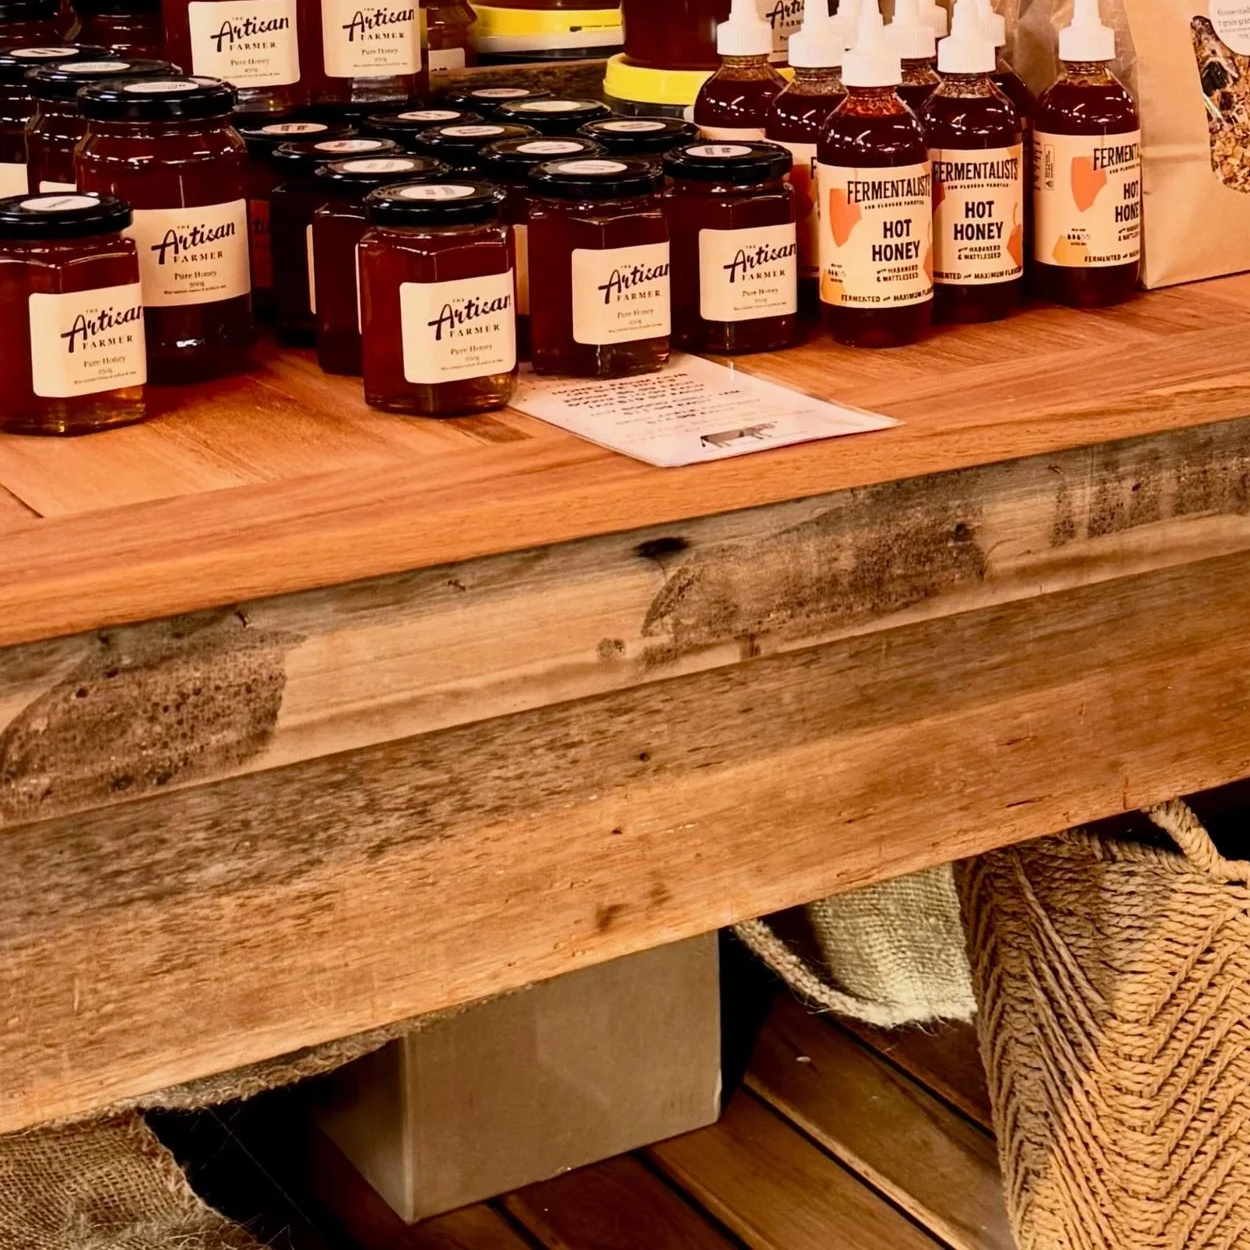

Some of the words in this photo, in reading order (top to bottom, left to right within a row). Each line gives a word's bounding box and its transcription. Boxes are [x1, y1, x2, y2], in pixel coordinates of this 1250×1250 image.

[342, 7, 415, 42] Artisan
[779, 18, 804, 28] FARM
[210, 16, 289, 53] Artisan
[360, 32, 405, 41] FARMER
[229, 42, 276, 51] FARMER
[1093, 142, 1138, 171] FERMENT
[931, 157, 1018, 184] FERMENTALISTS
[964, 200, 995, 219] HOT
[1115, 201, 1139, 223] HONE
[883, 218, 912, 239] HOT
[953, 221, 1004, 241] HONEY
[151, 222, 235, 265] Artisan
[871, 240, 921, 262] HONEY
[173, 250, 224, 263] FARMER
[723, 243, 796, 284] Artisan
[1084, 253, 1121, 263] FERMENTED
[174, 272, 192, 281] Pure
[194, 269, 217, 279] Honey
[742, 269, 786, 281] FARMER
[617, 289, 661, 302] FARMER
[841, 294, 880, 303] FERMENTED
[427, 294, 511, 341] Artisan
[449, 324, 501, 338] FARMER
[82, 334, 134, 350] FARMER
[450, 347, 468, 355] Pure
[469, 344, 493, 353] Honey
[83, 360, 101, 368] Pure
[102, 356, 126, 365] Honey
